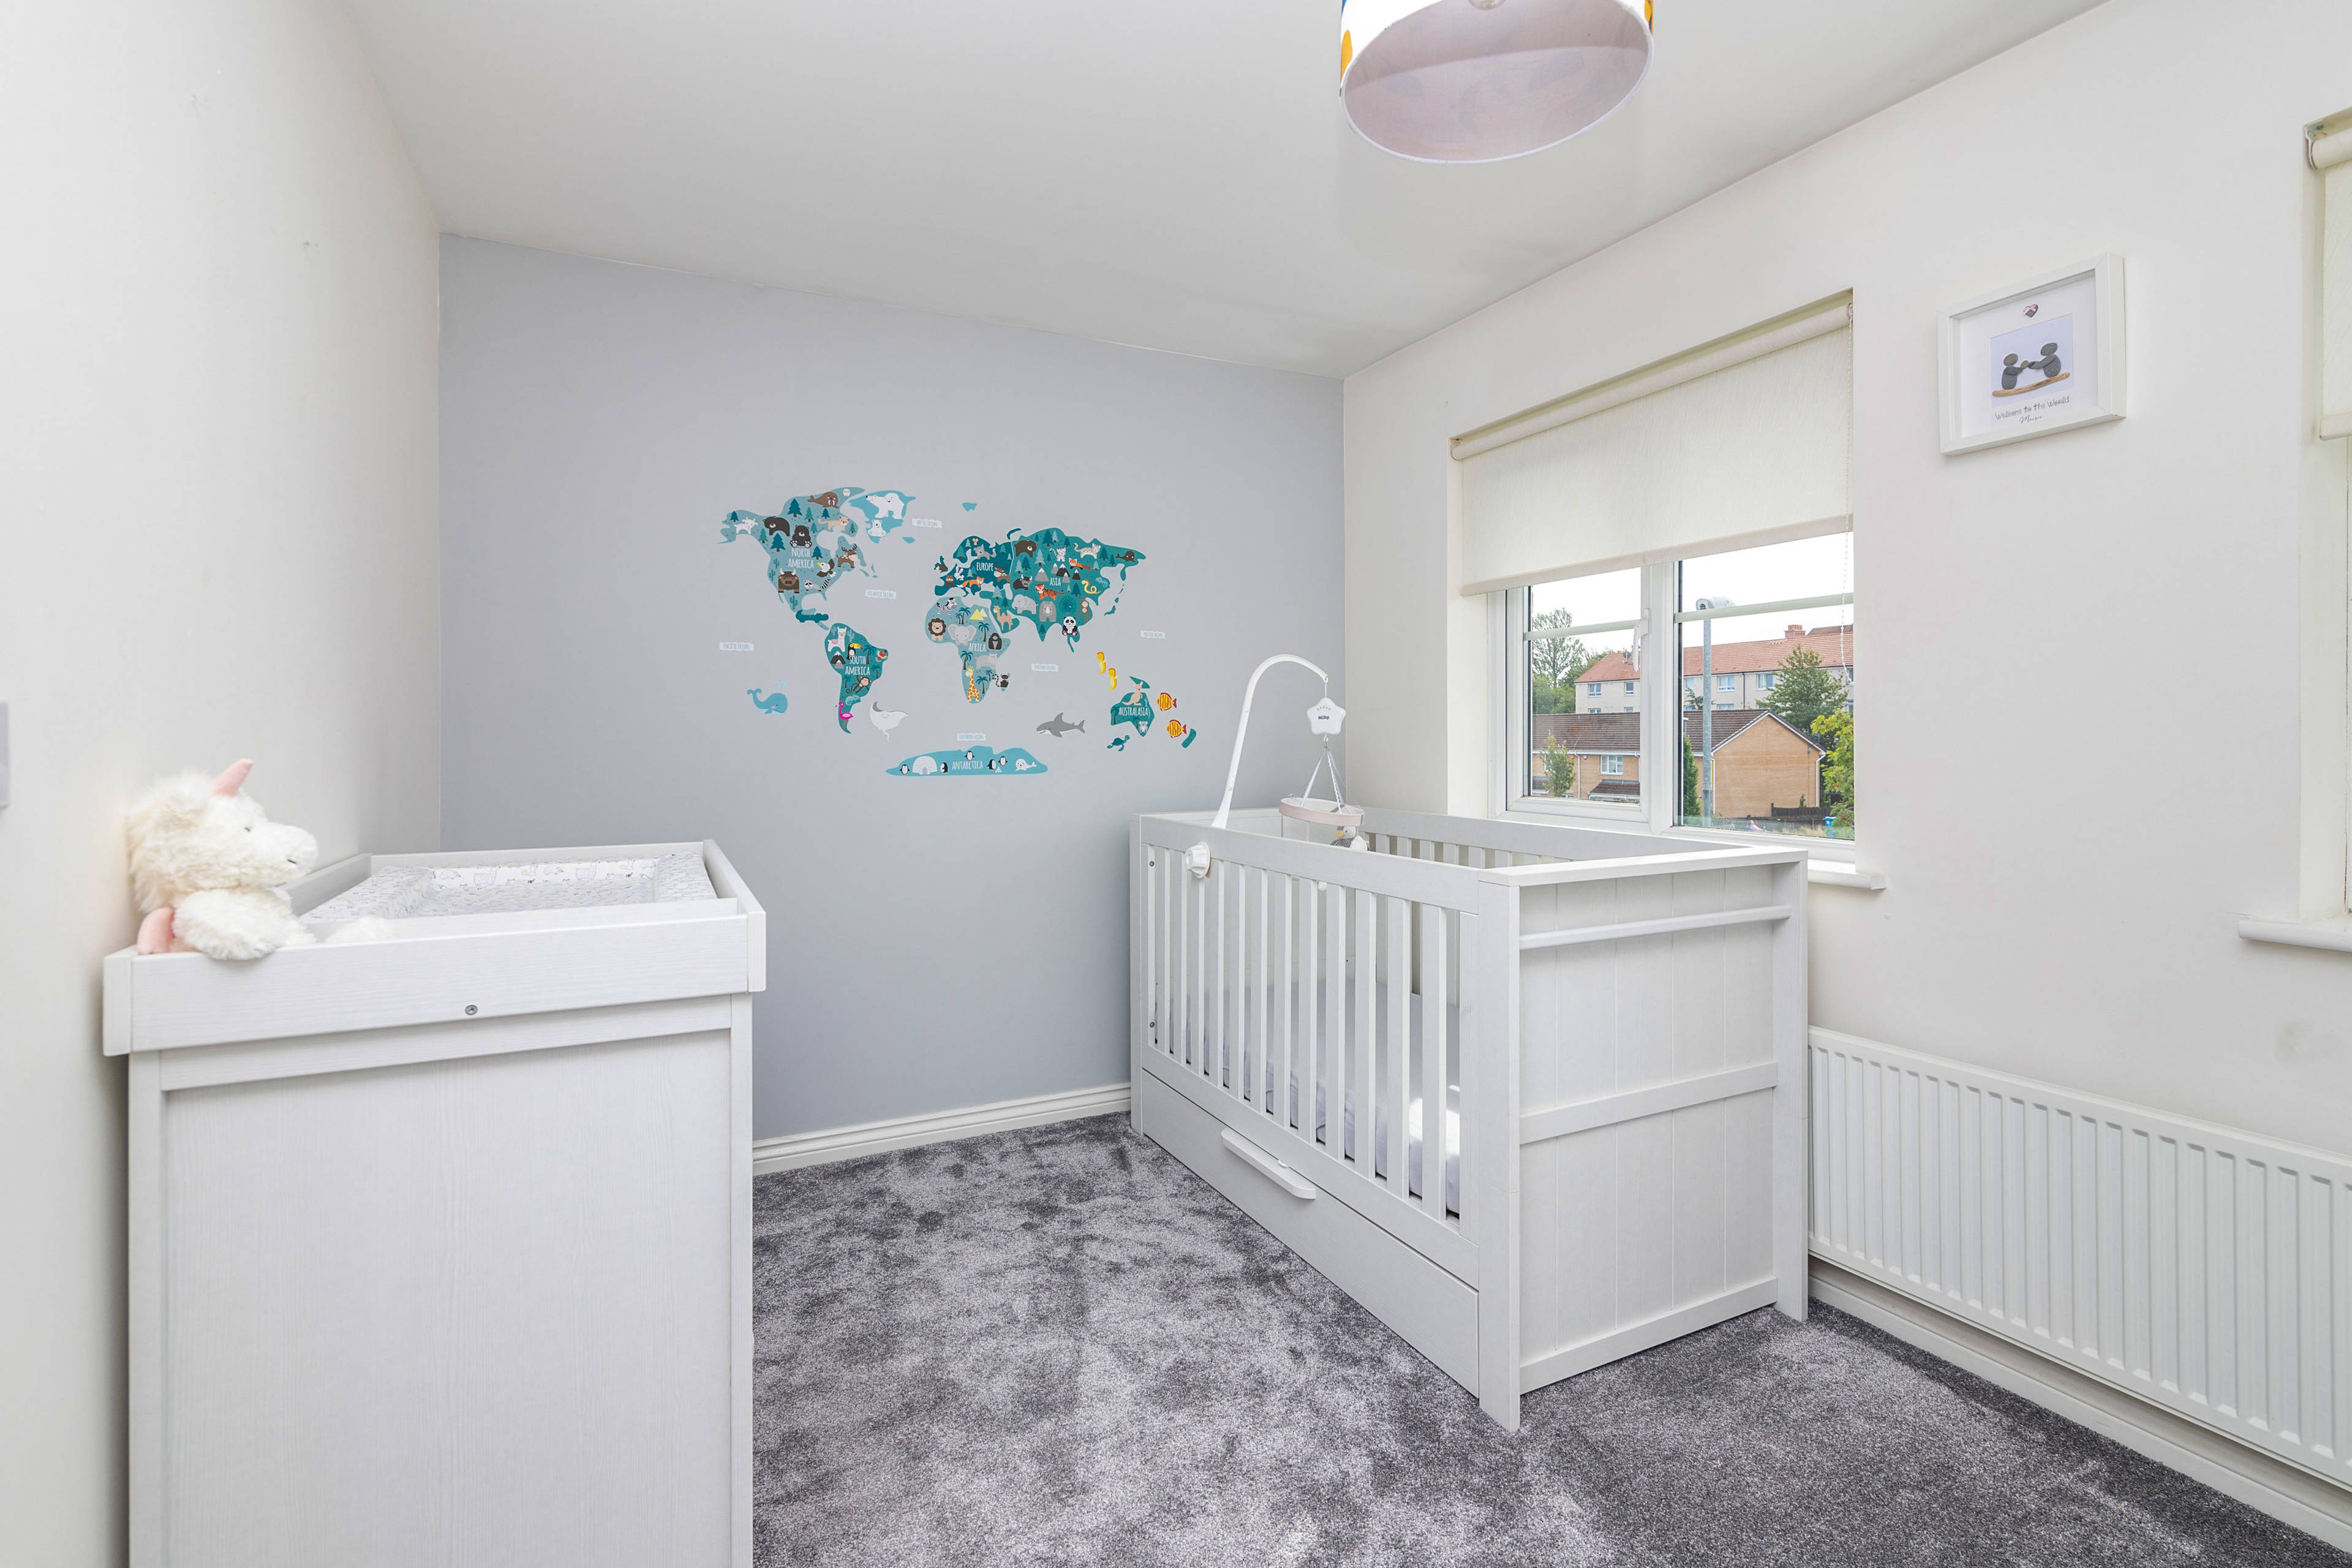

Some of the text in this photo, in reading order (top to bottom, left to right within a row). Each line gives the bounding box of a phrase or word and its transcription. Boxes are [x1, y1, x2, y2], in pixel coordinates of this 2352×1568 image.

[2033, 402, 2046, 411] the
[791, 548, 810, 557] NORTH
[788, 559, 814, 568] AMERICA
[976, 562, 993, 571] EUROPE
[1049, 578, 1061, 586] ASIA
[968, 643, 986, 652] AFRICA
[849, 655, 866, 665] SOUTH
[845, 666, 870, 676] AMERICA
[1118, 706, 1148, 716] AUSTRALASIA
[952, 760, 983, 770] ANTARCTICA
